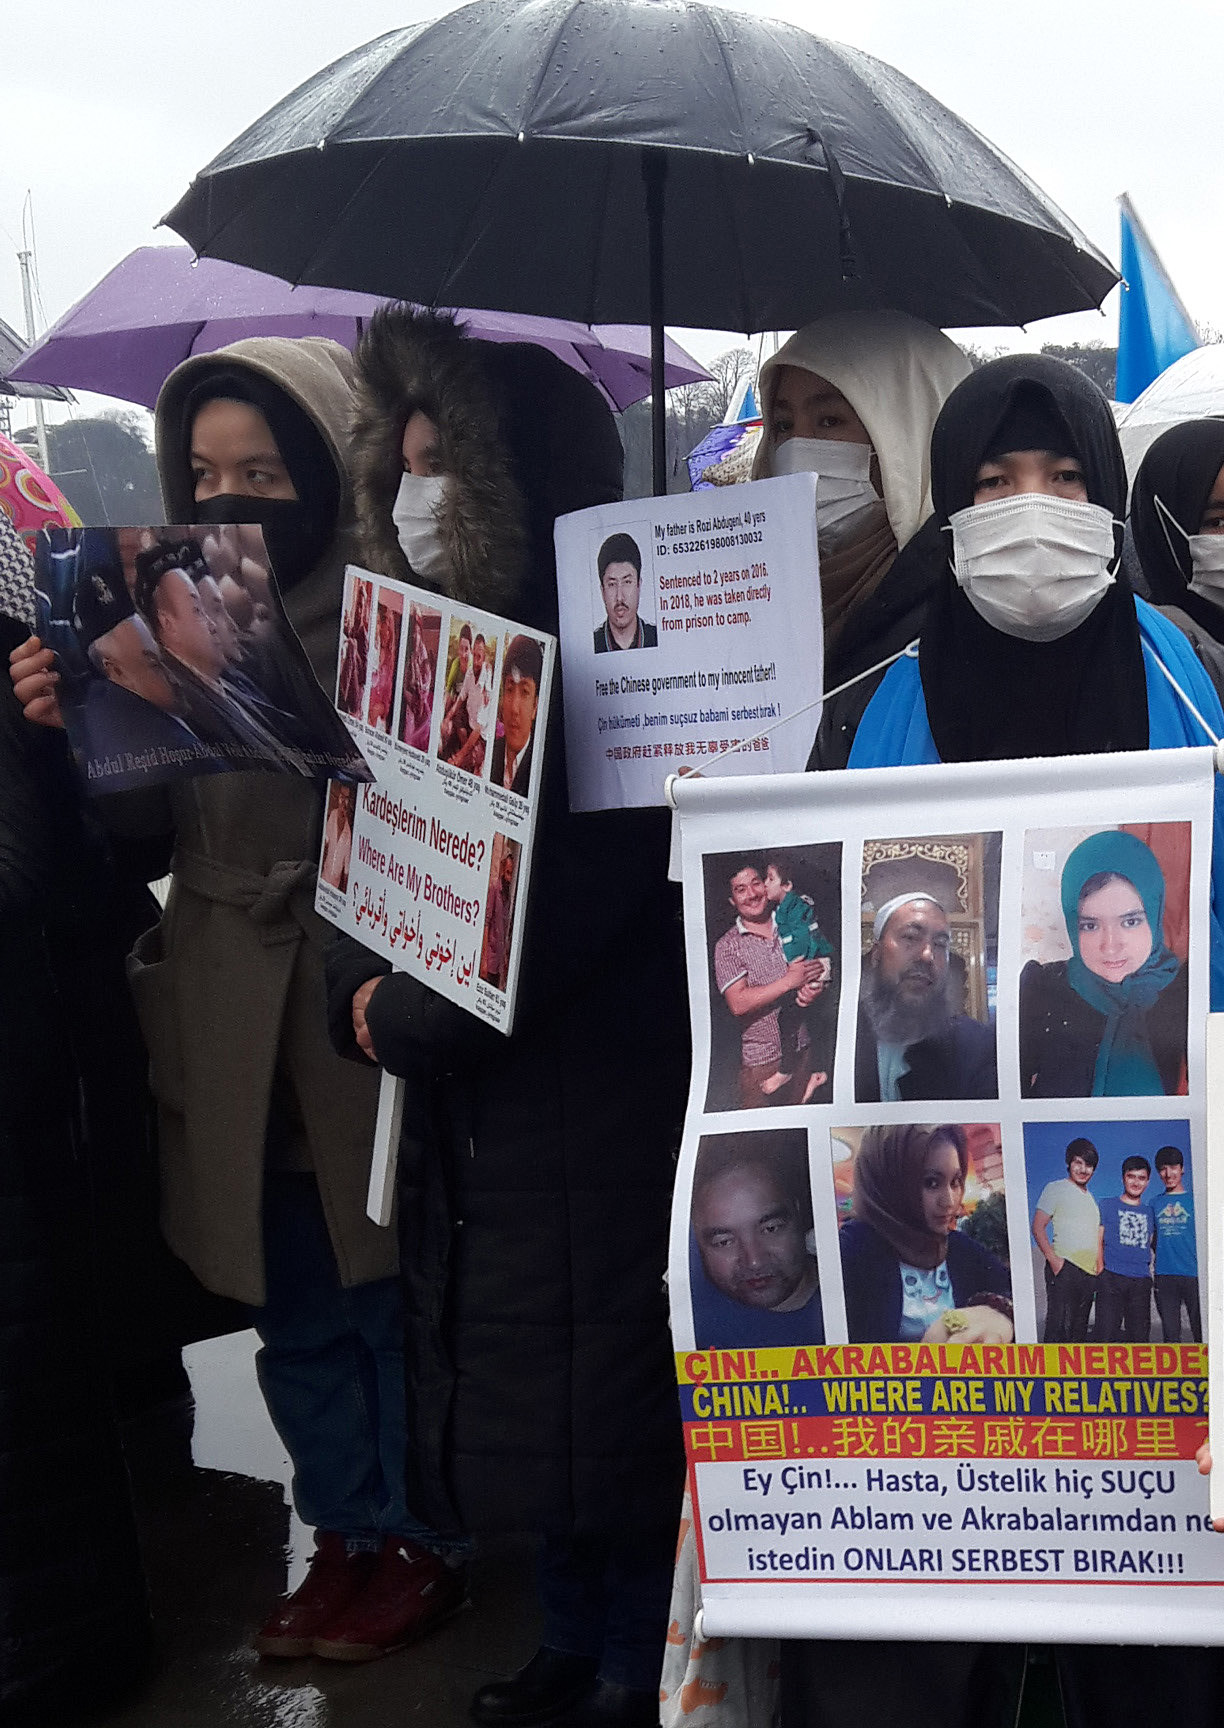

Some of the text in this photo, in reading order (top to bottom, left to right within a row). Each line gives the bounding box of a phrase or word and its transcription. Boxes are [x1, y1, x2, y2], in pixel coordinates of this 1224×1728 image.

[655, 525, 665, 540] My
[667, 523, 687, 537] father
[689, 521, 694, 533] is
[696, 519, 711, 533] Rozi
[744, 511, 751, 524] 40
[752, 511, 765, 527] yers
[657, 531, 762, 556] ID: 653226198008130032
[660, 563, 769, 590] Sentenced to 2 years on 2016.
[660, 584, 771, 610] In 2018, he was taken directly
[662, 611, 751, 632] from prison to camp.
[596, 680, 608, 696] Free
[609, 678, 619, 694] the
[621, 676, 650, 693] Chinese
[652, 671, 696, 695] government
[698, 671, 706, 687] to
[708, 672, 720, 690] my
[722, 666, 753, 685] innocent
[670, 713, 697, 727] suçsuz
[732, 705, 759, 720] serbest
[87, 753, 124, 780] Abdul
[362, 783, 427, 844] Kardeşlerim
[429, 816, 486, 871] Nerede?
[358, 835, 480, 926] Where Are My Brothers?
[684, 1346, 779, 1389] ÇİN!..
[792, 1345, 1045, 1378] AKRABALARIM
[1058, 1345, 1209, 1376] NEREDE
[693, 1383, 808, 1418] CHINA!..
[824, 1382, 923, 1415] WHERE
[932, 1381, 984, 1412] ARE
[994, 1381, 1034, 1412] MY
[743, 1463, 1176, 1500] Ey Çin!... Hasta, Üstelik hiç SUÇU
[709, 1508, 821, 1537] olmayan
[831, 1507, 913, 1531] Ablam
[923, 1513, 952, 1531] ve
[961, 1508, 1176, 1532] Akrabalarımdan
[748, 1547, 1184, 1575] istedin ONLARI SERBEST BIRAK!!!
